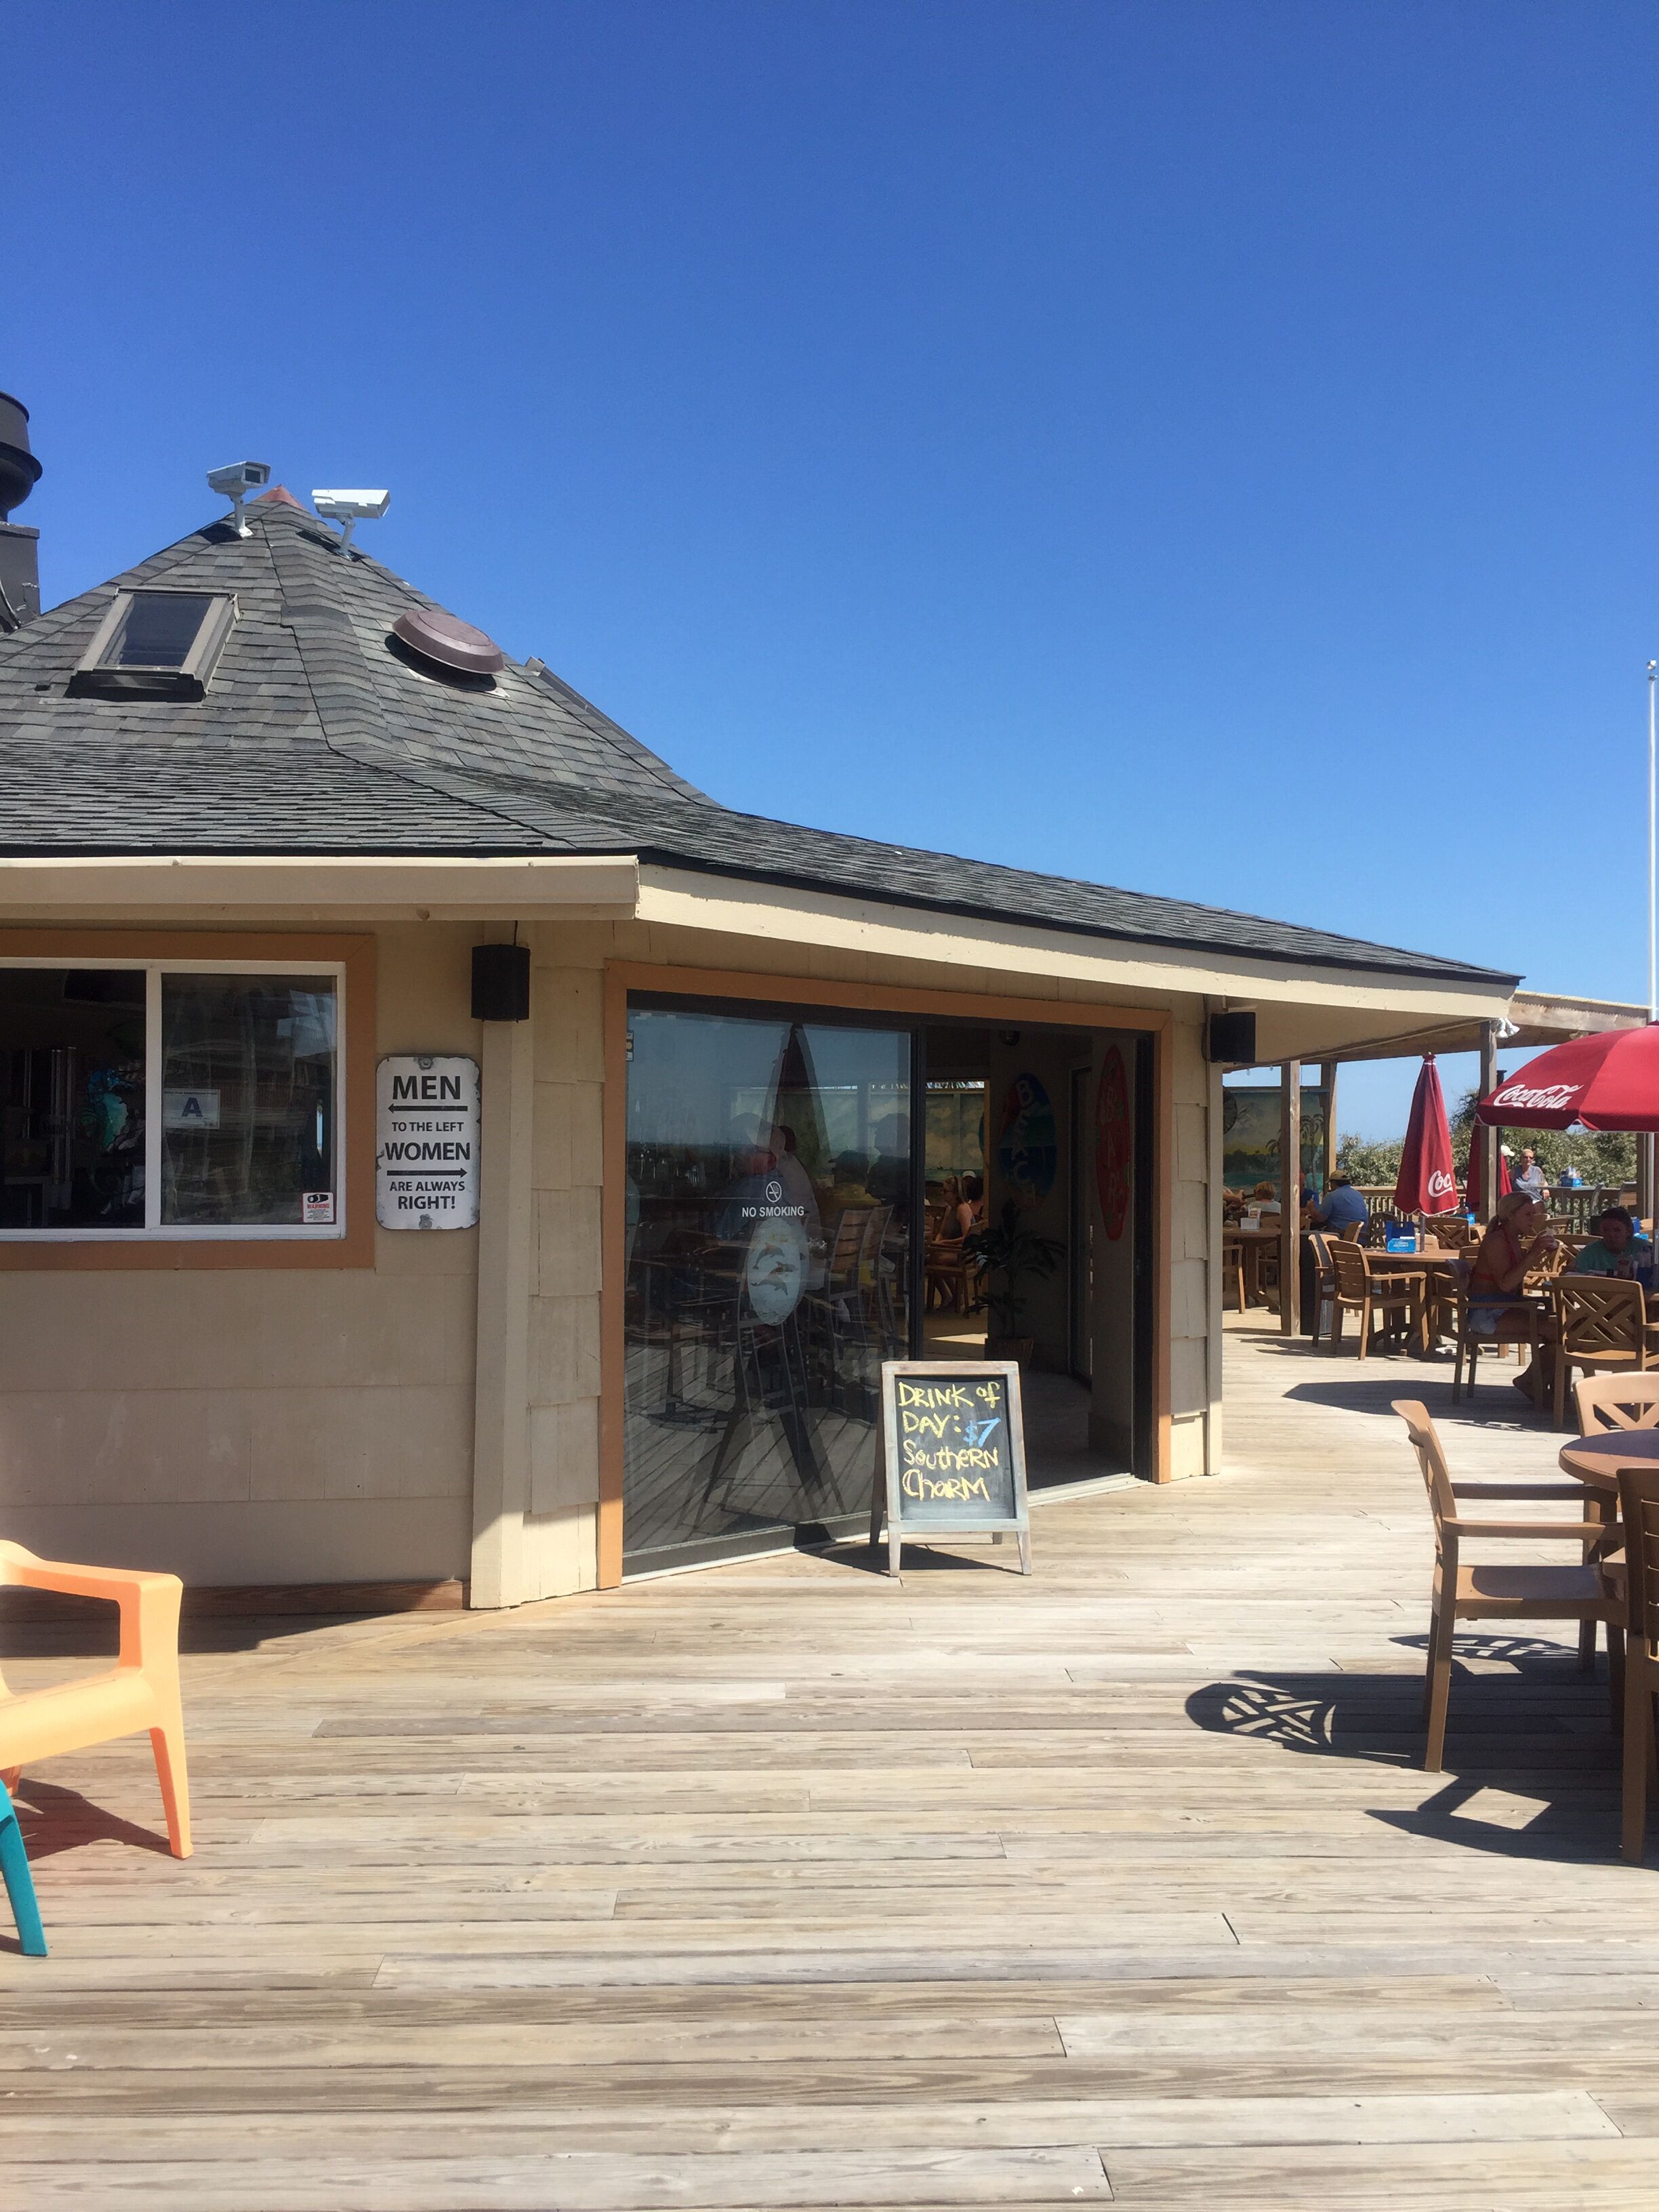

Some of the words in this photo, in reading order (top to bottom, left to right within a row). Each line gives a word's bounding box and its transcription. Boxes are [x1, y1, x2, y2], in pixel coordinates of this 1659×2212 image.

[392, 1076, 461, 1099] MEN
[182, 1097, 203, 1117] A
[392, 1122, 407, 1132] TO
[409, 1122, 432, 1132] THE
[436, 1122, 464, 1132] LEFT
[385, 1142, 470, 1161] WOMEN
[1011, 1080, 1036, 1206] BEACH
[390, 1181, 412, 1191] ARE
[415, 1181, 465, 1191] ALWAYS
[398, 1195, 455, 1209] RIGHT!
[742, 1207, 756, 1217] NO
[759, 1206, 804, 1217] SMOKING
[898, 1381, 975, 1409] DRINK
[976, 1381, 1001, 1409] of
[902, 1410, 962, 1438] DAY:
[963, 1417, 1001, 1447] $7
